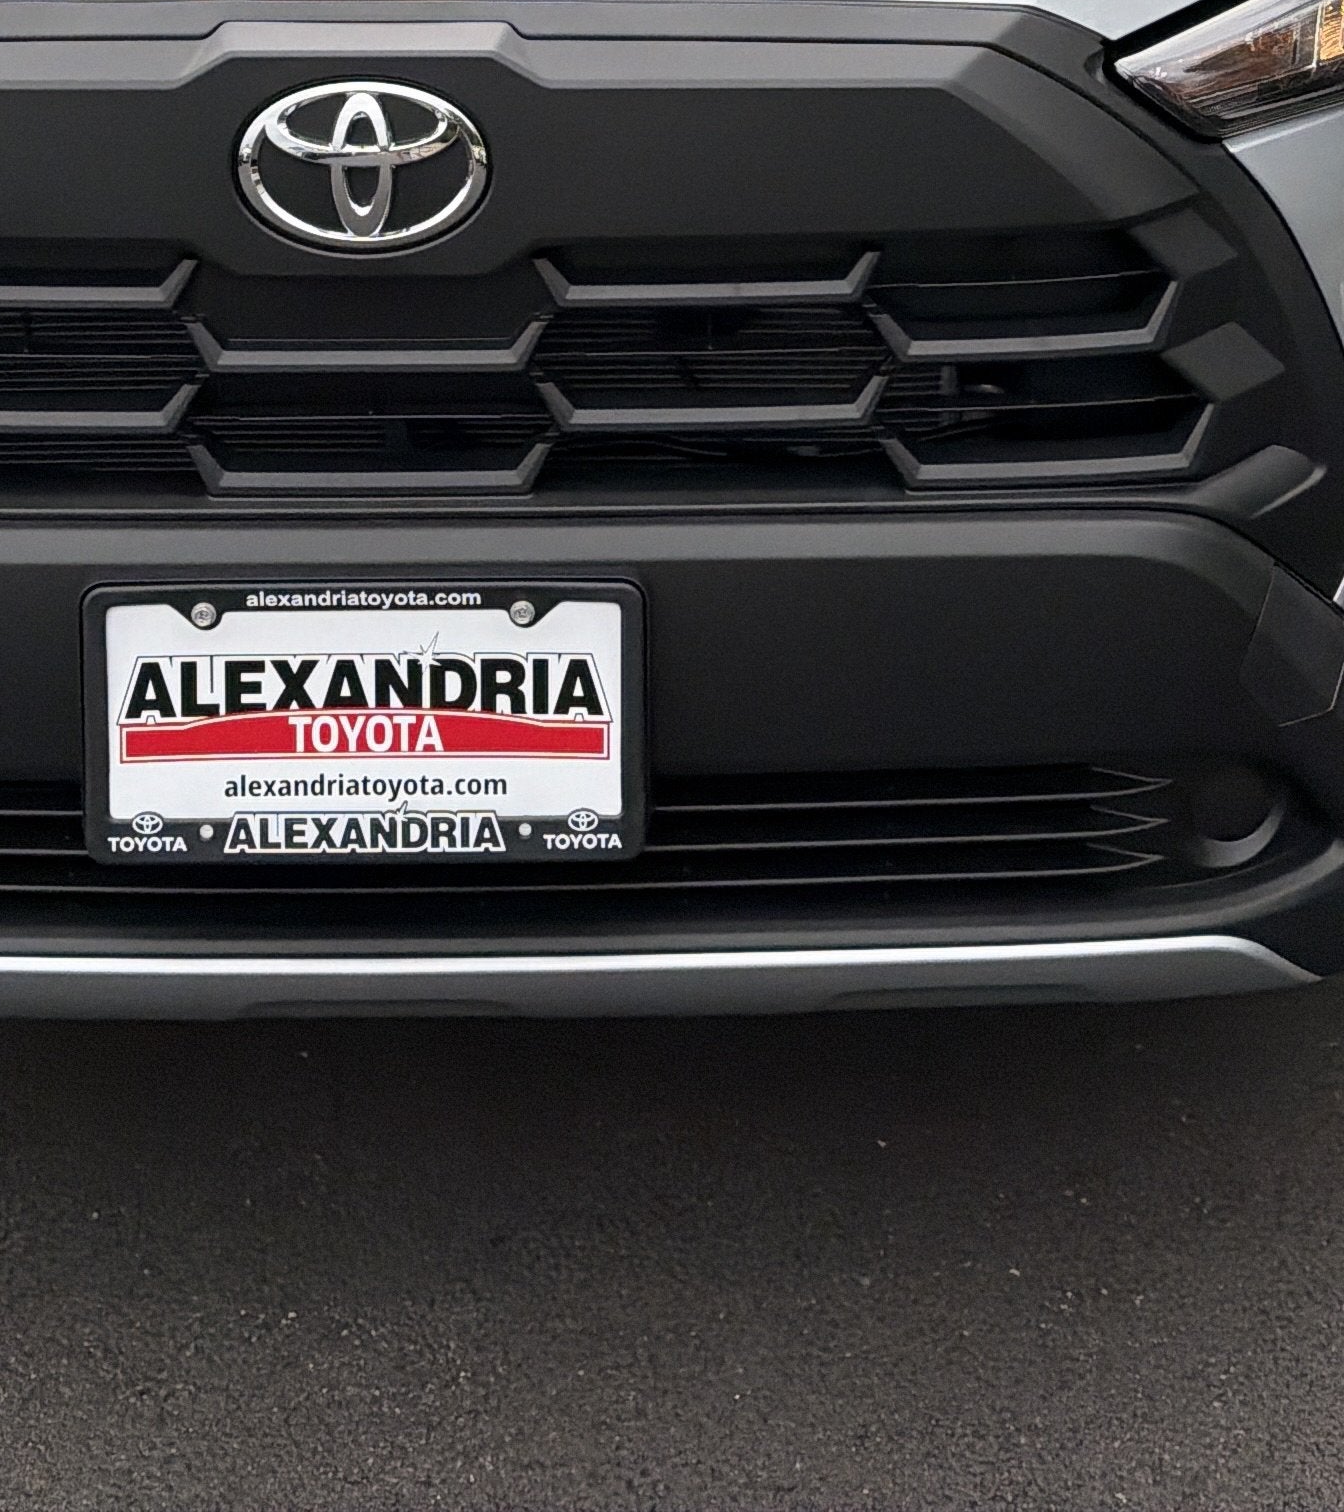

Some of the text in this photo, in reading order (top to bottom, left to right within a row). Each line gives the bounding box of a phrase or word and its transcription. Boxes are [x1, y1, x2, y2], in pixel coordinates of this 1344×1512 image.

[245, 590, 482, 609] alexandriatoyota.com
[124, 658, 604, 720] ALEXANDRIA
[288, 714, 444, 752] TOYOTA
[224, 774, 507, 801] alexandriatoyota.com
[107, 836, 188, 853] TOYOTA
[223, 813, 506, 854] ALEXANDRIA
[543, 833, 623, 851] TOYOTA
